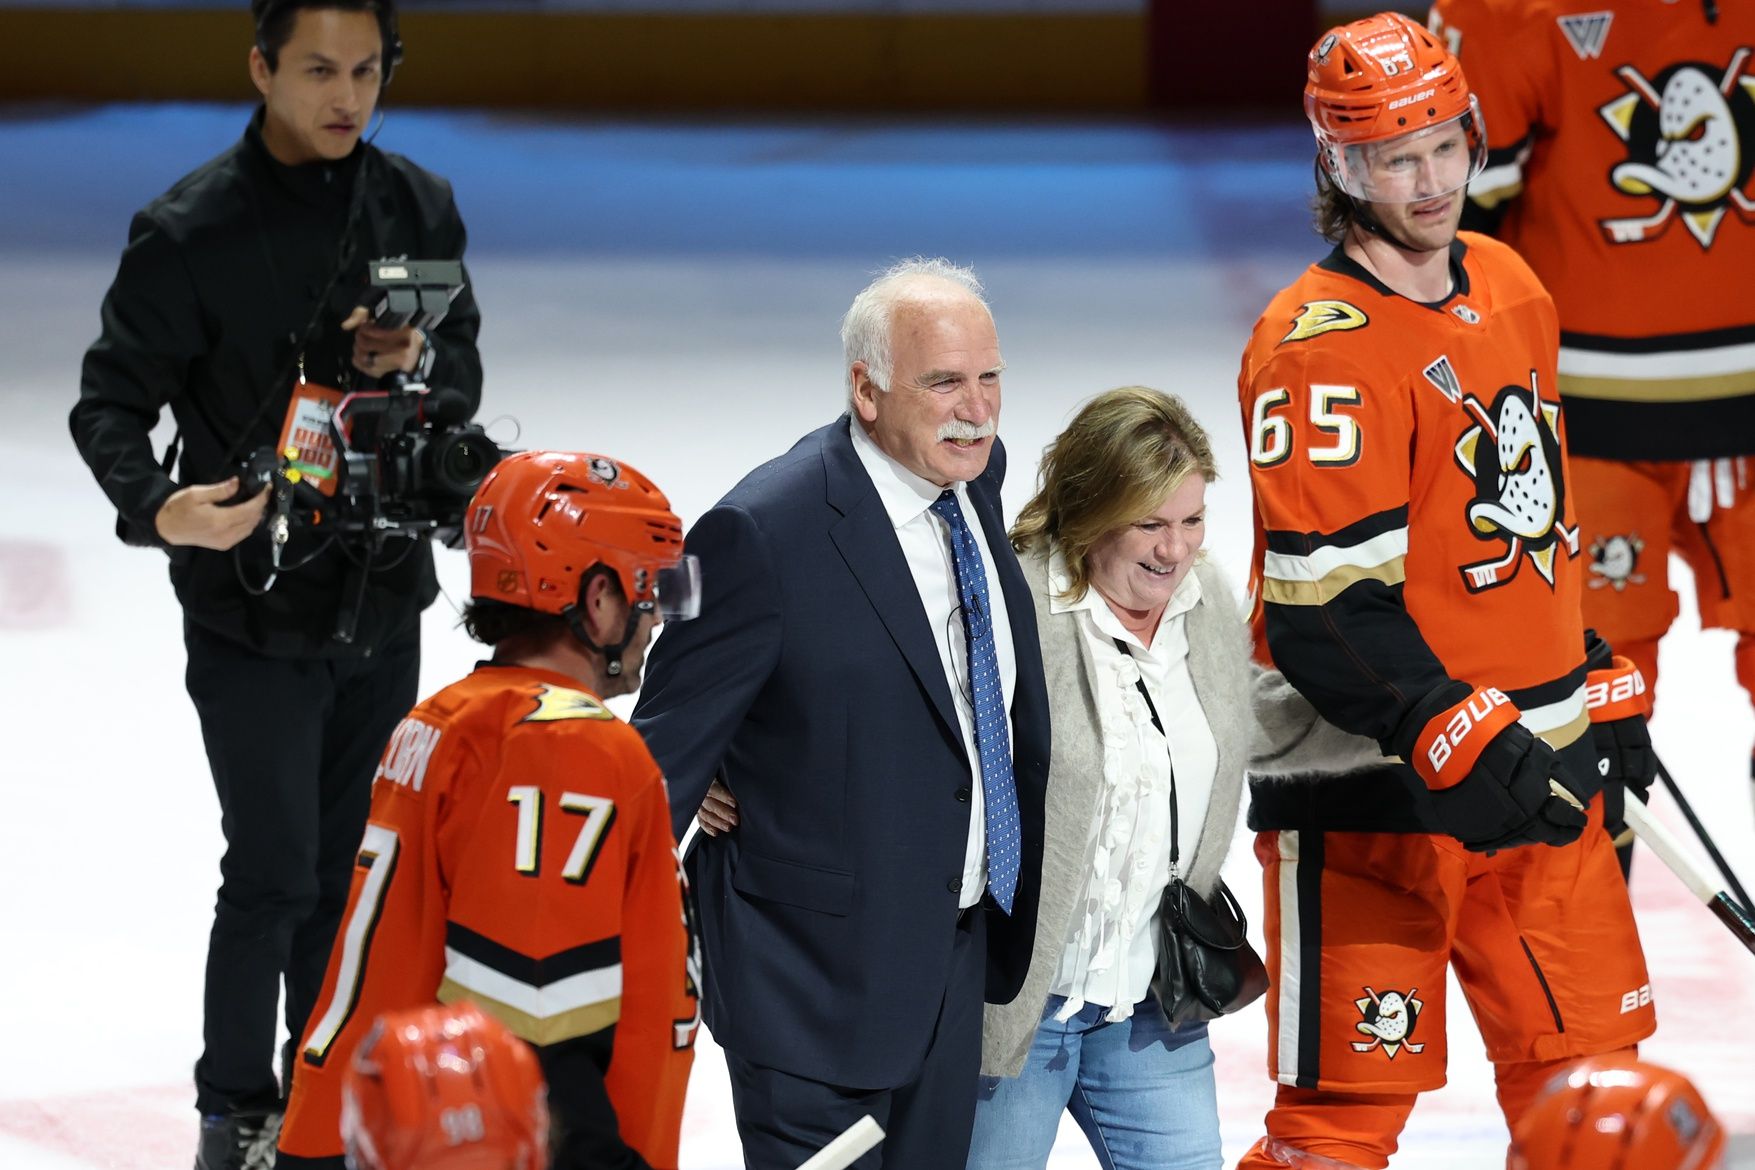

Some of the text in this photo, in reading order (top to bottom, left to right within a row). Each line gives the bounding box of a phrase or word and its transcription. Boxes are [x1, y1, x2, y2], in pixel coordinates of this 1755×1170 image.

[1388, 88, 1436, 110] BAUER
[1251, 384, 1365, 468] 65
[473, 505, 493, 532] 17
[372, 718, 442, 792] ORN
[507, 786, 617, 886] 17
[1620, 984, 1651, 1014] BA
